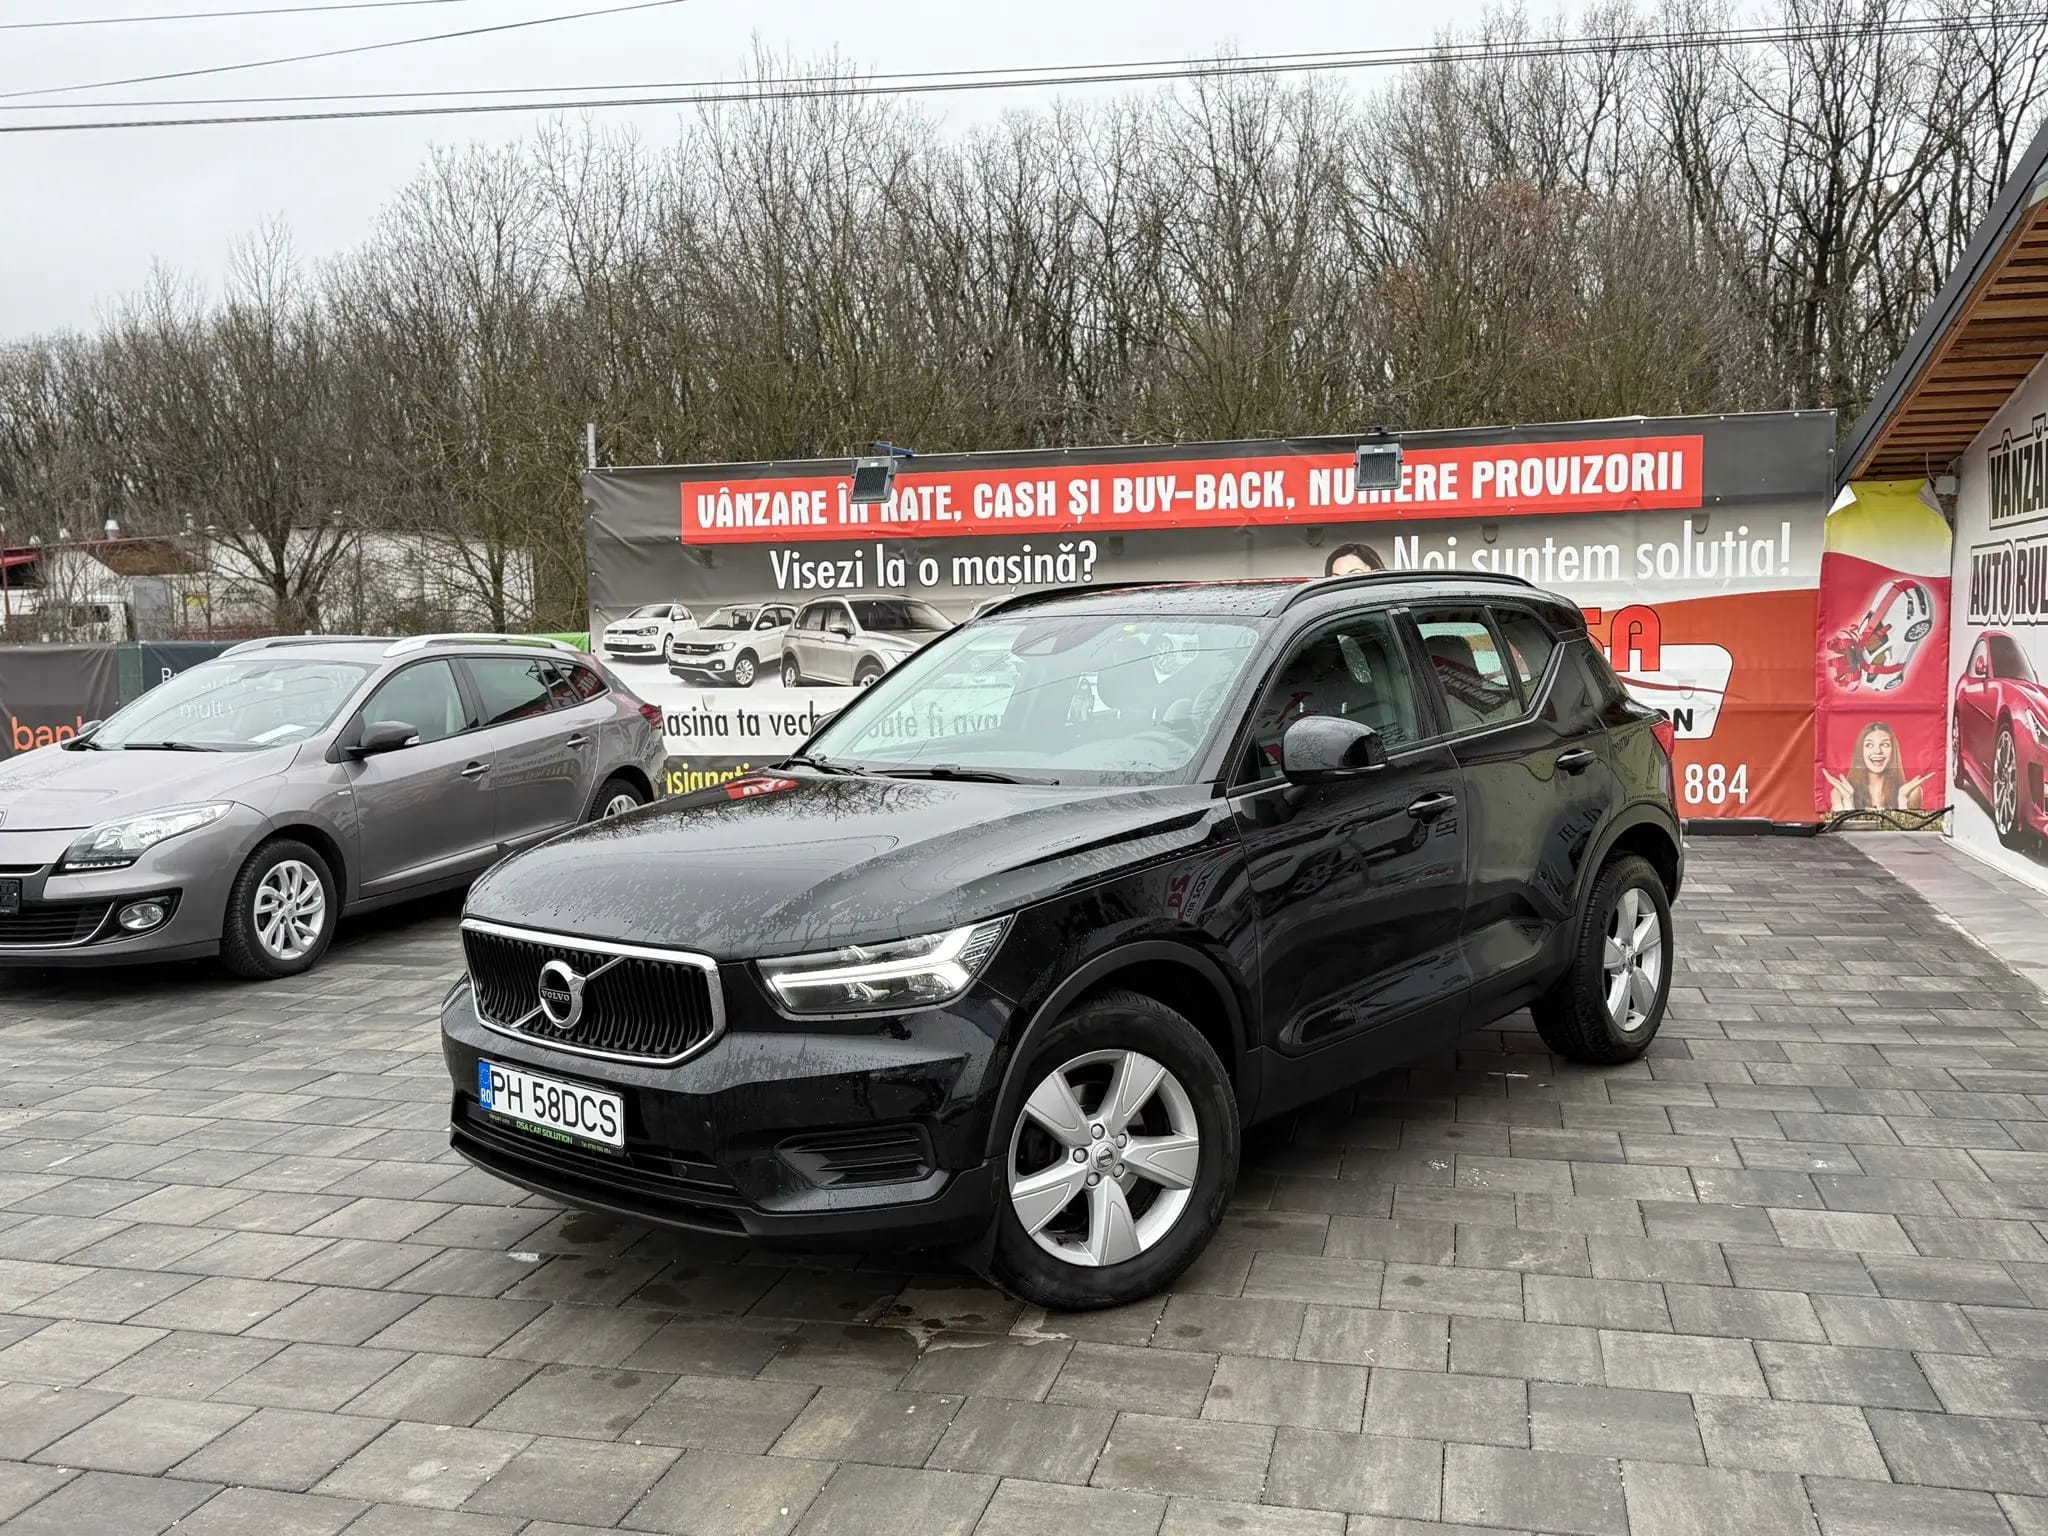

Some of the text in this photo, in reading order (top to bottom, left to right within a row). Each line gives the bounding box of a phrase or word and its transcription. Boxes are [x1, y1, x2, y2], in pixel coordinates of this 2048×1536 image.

[697, 486, 828, 528] VÂNZARE
[880, 484, 963, 523] RATE,
[973, 479, 1057, 520] CASH
[1067, 478, 1100, 524] ȘI
[1111, 470, 1296, 515] BUY-BACK,
[1472, 451, 1683, 500] PROVIZORII
[1990, 425, 2048, 521] VÂNZĂ
[769, 550, 864, 590] Visezi
[875, 543, 906, 588] la
[918, 557, 940, 587] o
[1470, 537, 1620, 583] suntem
[1969, 548, 2013, 617] AUTO
[736, 708, 761, 737] ta
[1684, 762, 1750, 804] 884
[540, 989, 570, 1002] VOLVO
[480, 1087, 492, 1103] RO
[490, 1070, 618, 1138] PH 58DCS
[541, 1127, 574, 1145] SOLUTION
